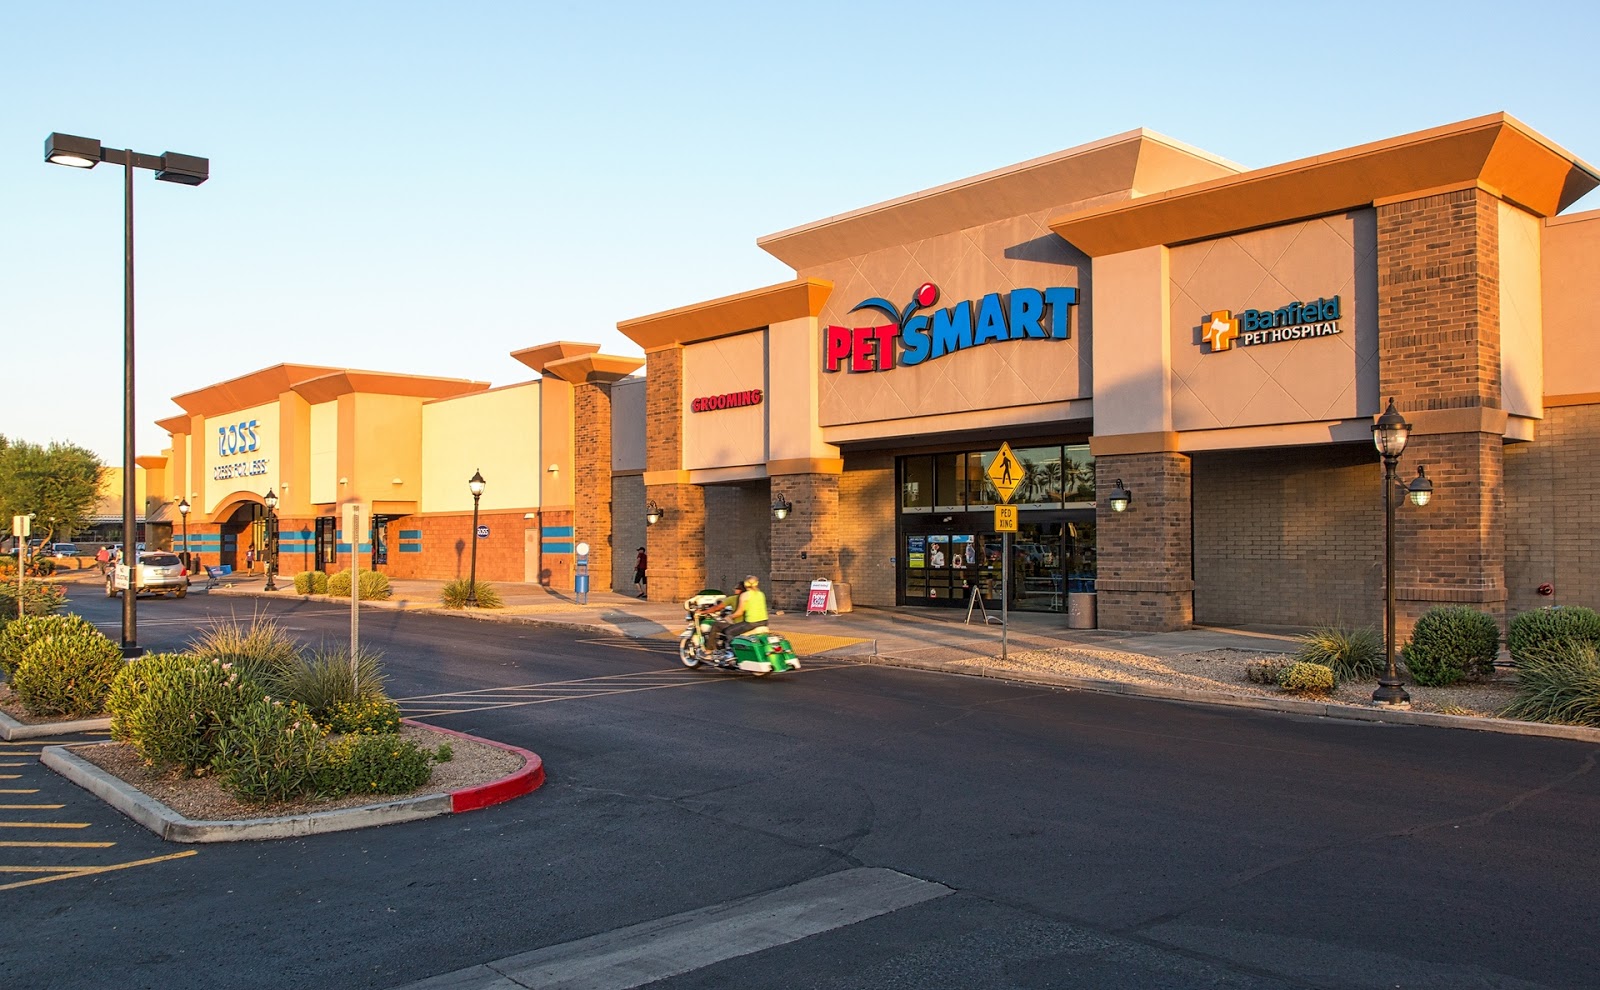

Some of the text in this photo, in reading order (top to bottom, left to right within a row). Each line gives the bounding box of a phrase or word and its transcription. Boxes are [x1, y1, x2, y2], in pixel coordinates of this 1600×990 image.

[1244, 294, 1340, 331] Banfield
[826, 286, 1078, 372] PETSMART
[1244, 321, 1341, 345] PET HOSPITAL
[692, 389, 762, 413] GROOMING
[218, 419, 260, 456] ROSS
[249, 459, 268, 476] LESS
[999, 519, 1013, 529] XING
[1000, 508, 1011, 518] PED
